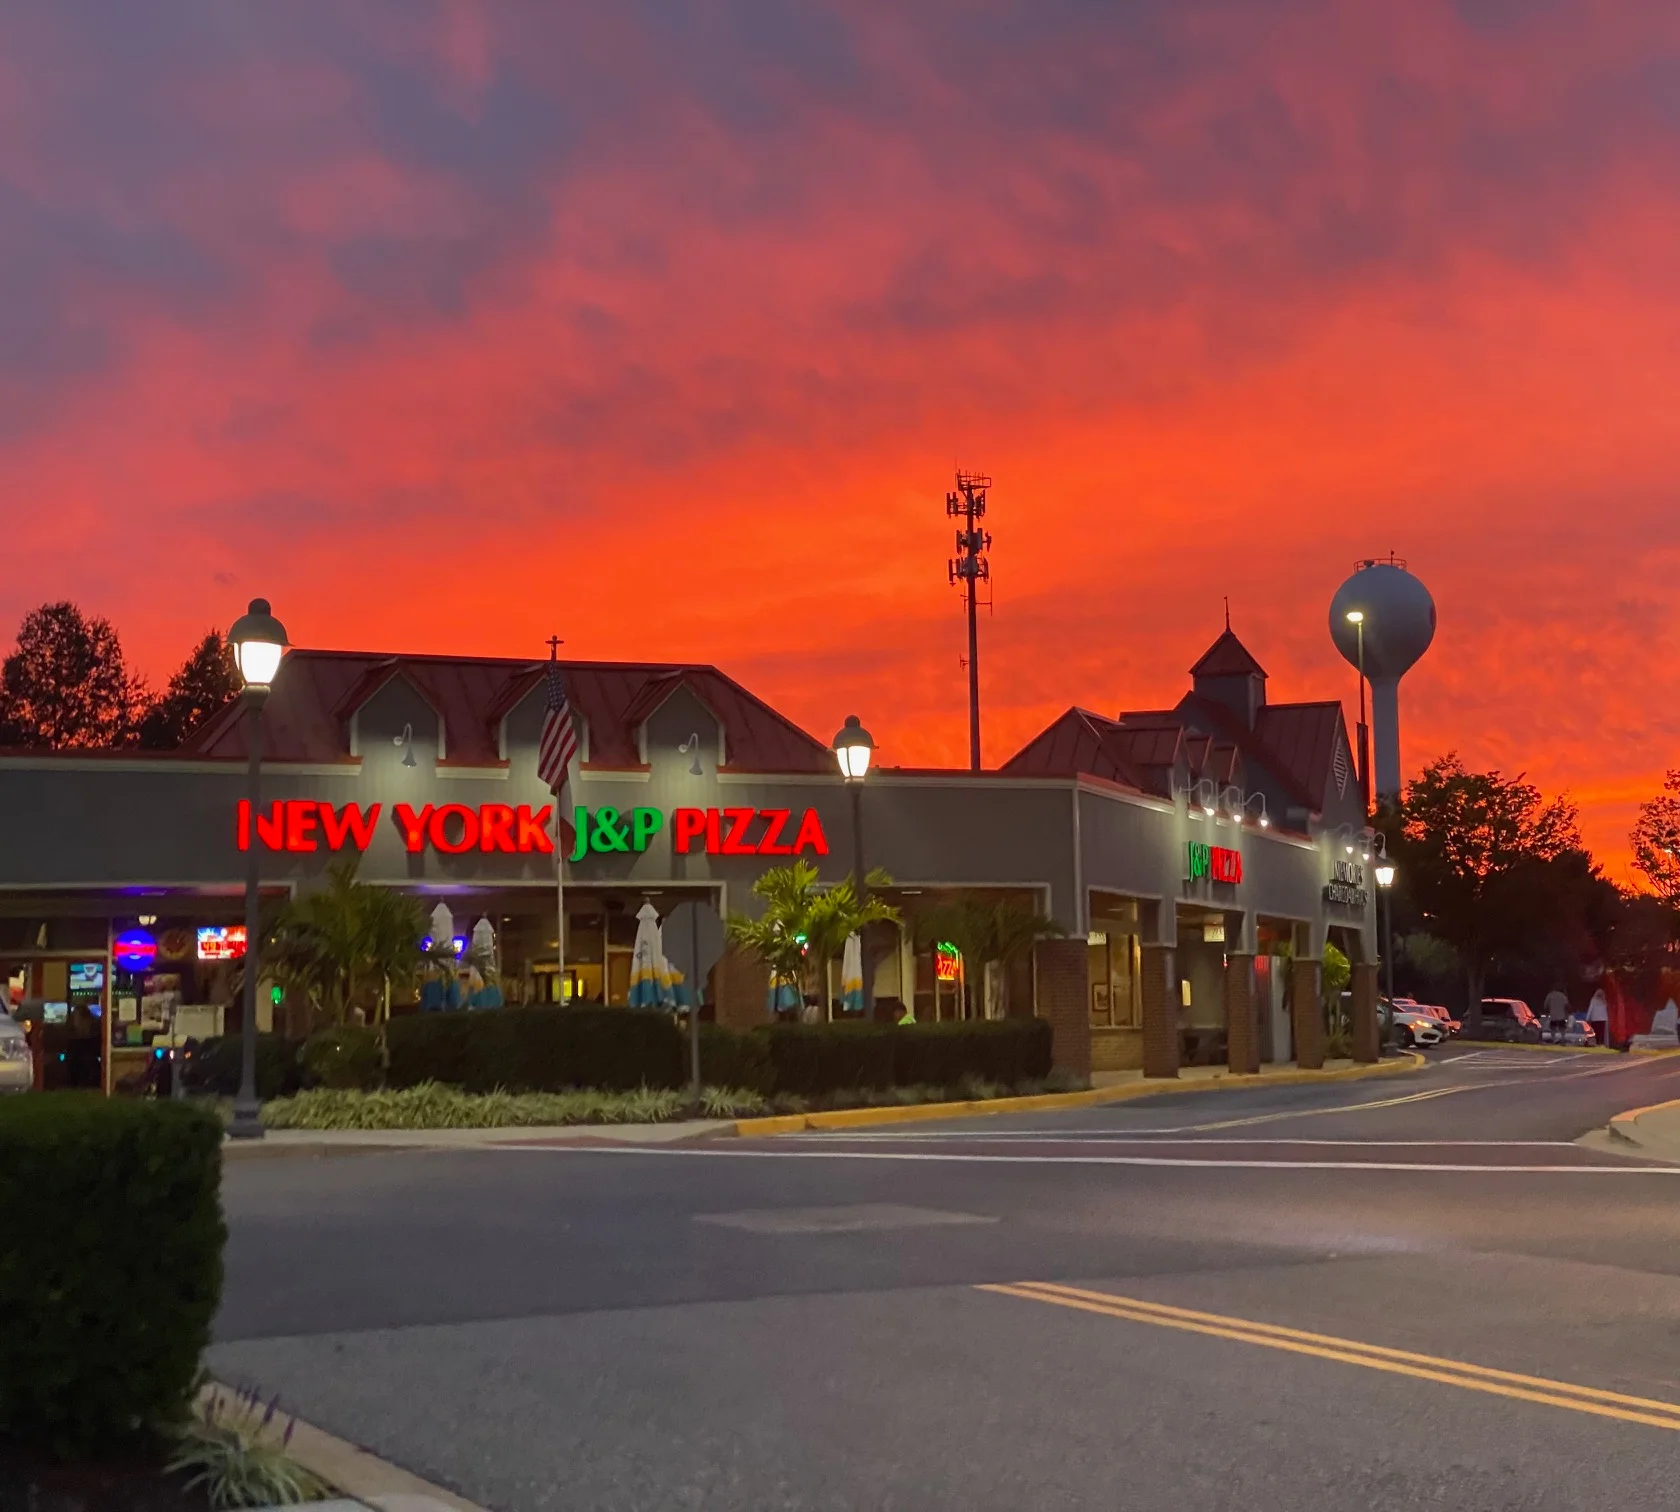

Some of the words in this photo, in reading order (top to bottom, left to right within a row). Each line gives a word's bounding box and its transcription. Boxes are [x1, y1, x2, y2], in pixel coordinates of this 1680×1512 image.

[238, 800, 382, 852] NEW
[395, 801, 556, 853] YORK
[569, 805, 664, 862] J&P
[676, 806, 829, 855] PIZZA
[1188, 840, 1210, 882] J&P
[1211, 845, 1243, 884] PIZZA
